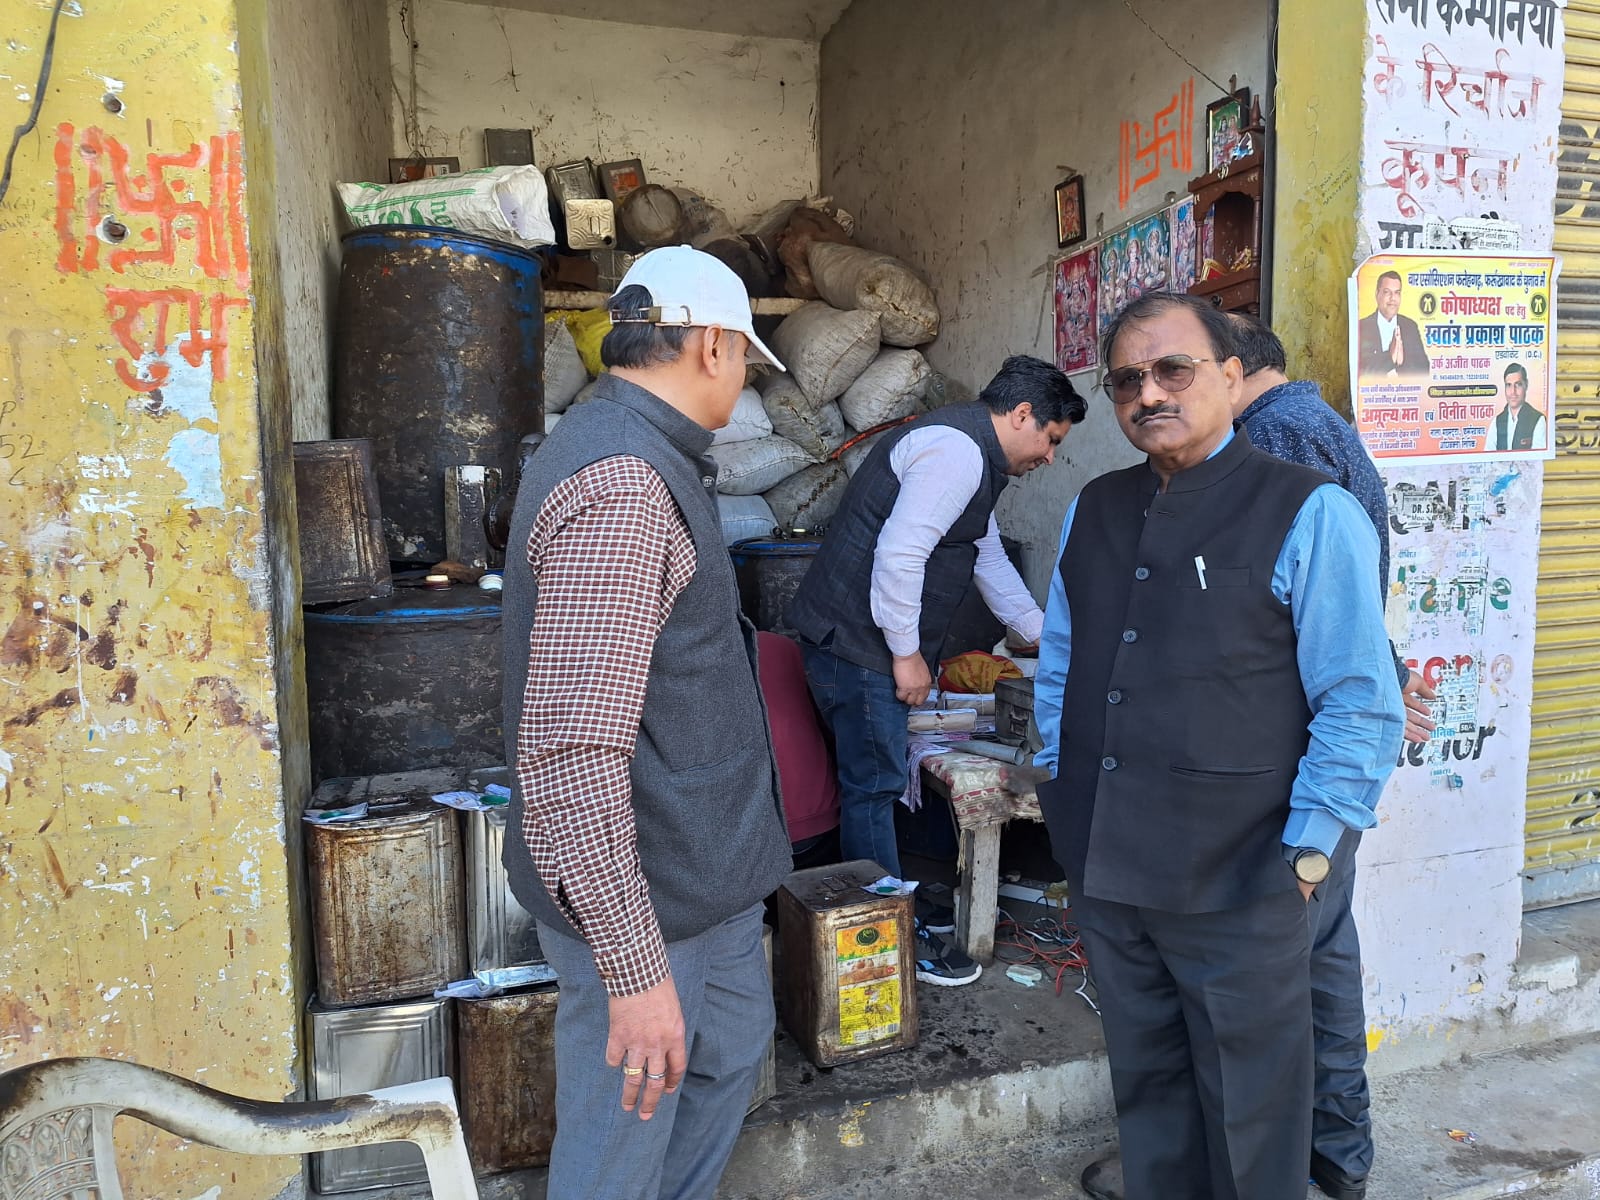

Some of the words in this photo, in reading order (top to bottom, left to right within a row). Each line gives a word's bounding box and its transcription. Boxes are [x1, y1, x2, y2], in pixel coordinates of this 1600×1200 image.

[1440, 290, 1502, 316] कोषाध्यक्ष
[1505, 305, 1515, 316] पद
[1425, 319, 1461, 347] स्वतंत्र
[1464, 323, 1506, 347] प्रकाश
[1509, 323, 1546, 345] पाठक
[1445, 355, 1468, 369] अजीत
[1362, 407, 1399, 428] अमूल्य
[1401, 407, 1419, 421] मत
[1438, 402, 1467, 419] विनीत
[1470, 404, 1494, 419] पाठक
